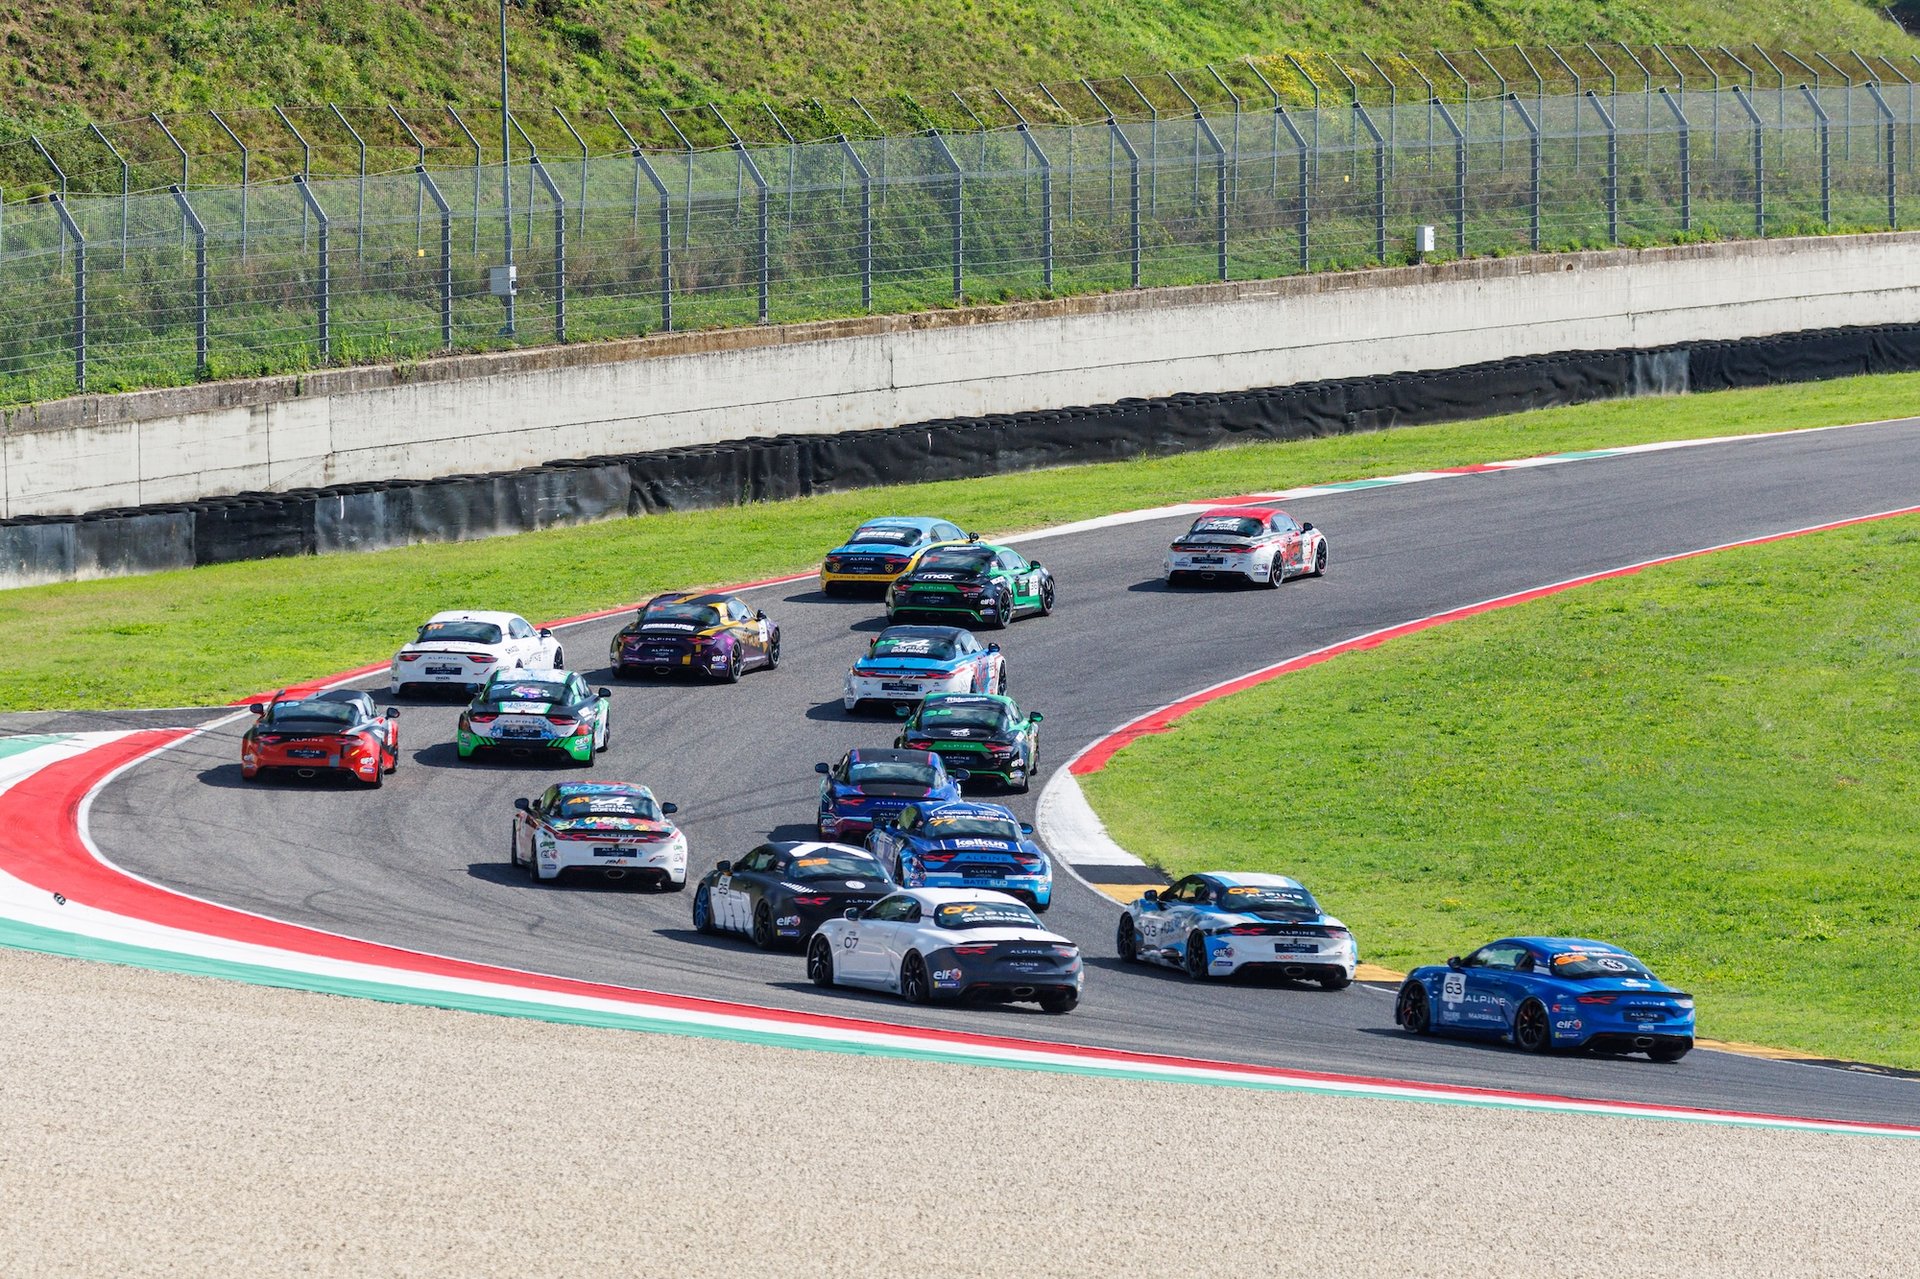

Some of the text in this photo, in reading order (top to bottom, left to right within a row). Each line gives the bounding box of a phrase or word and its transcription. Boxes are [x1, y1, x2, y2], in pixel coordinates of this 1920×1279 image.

[1246, 892, 1303, 900] ALPINE
[943, 904, 977, 915] 07
[961, 910, 1031, 919] ALPINE
[776, 916, 791, 926] elf
[1143, 925, 1157, 937] 03
[844, 937, 859, 949] 07
[933, 969, 951, 980] elf
[1445, 982, 1463, 995] 63
[1465, 994, 1506, 1007] ALPINE
[1468, 1012, 1502, 1023] MARSEILLE
[1556, 1020, 1572, 1029] elf
